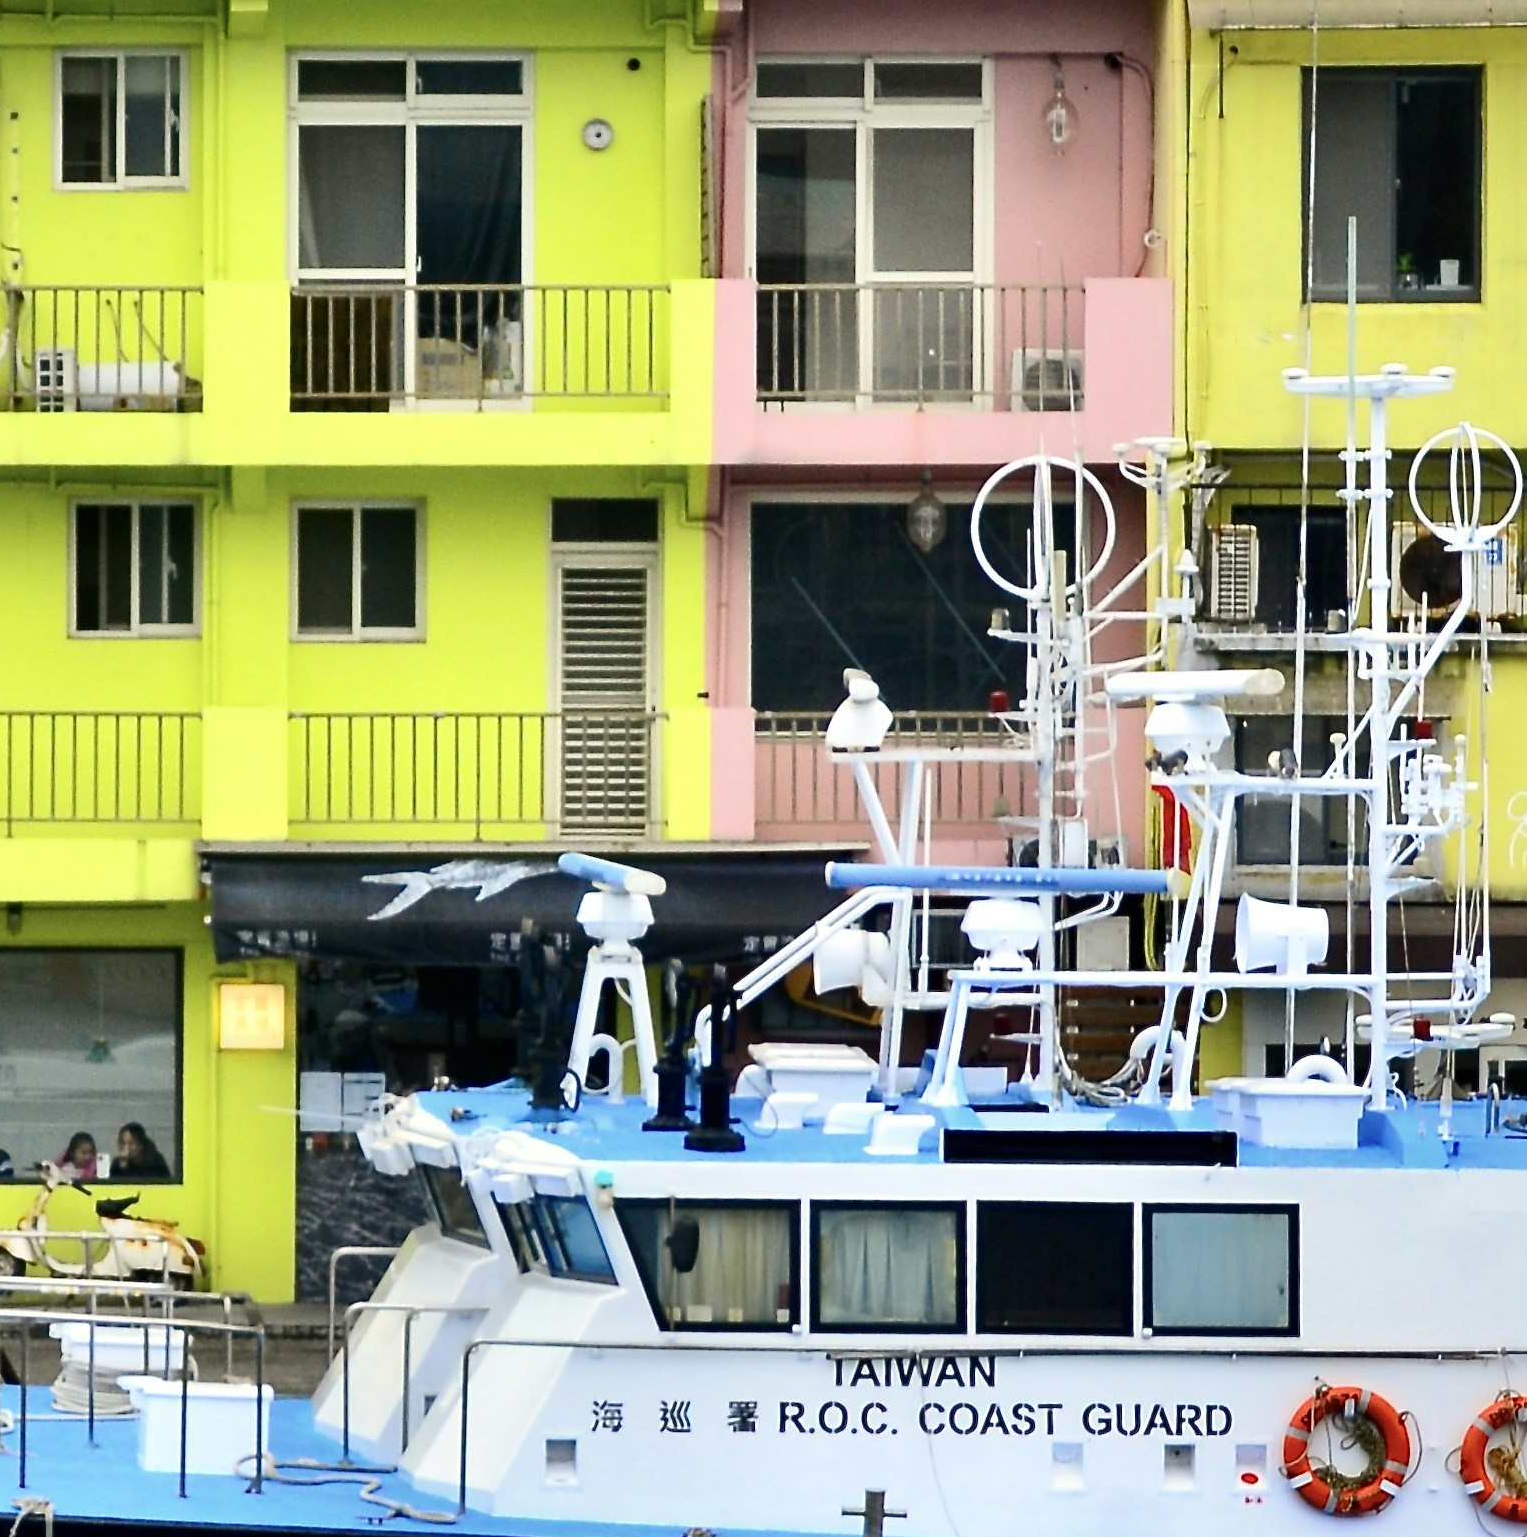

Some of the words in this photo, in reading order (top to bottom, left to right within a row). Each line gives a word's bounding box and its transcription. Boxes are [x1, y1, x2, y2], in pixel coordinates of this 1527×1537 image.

[831, 1358, 996, 1387] TAIWAN
[779, 1401, 898, 1434] R.O.C.
[919, 1403, 1062, 1435] COAST
[1082, 1403, 1232, 1436] GUARD
